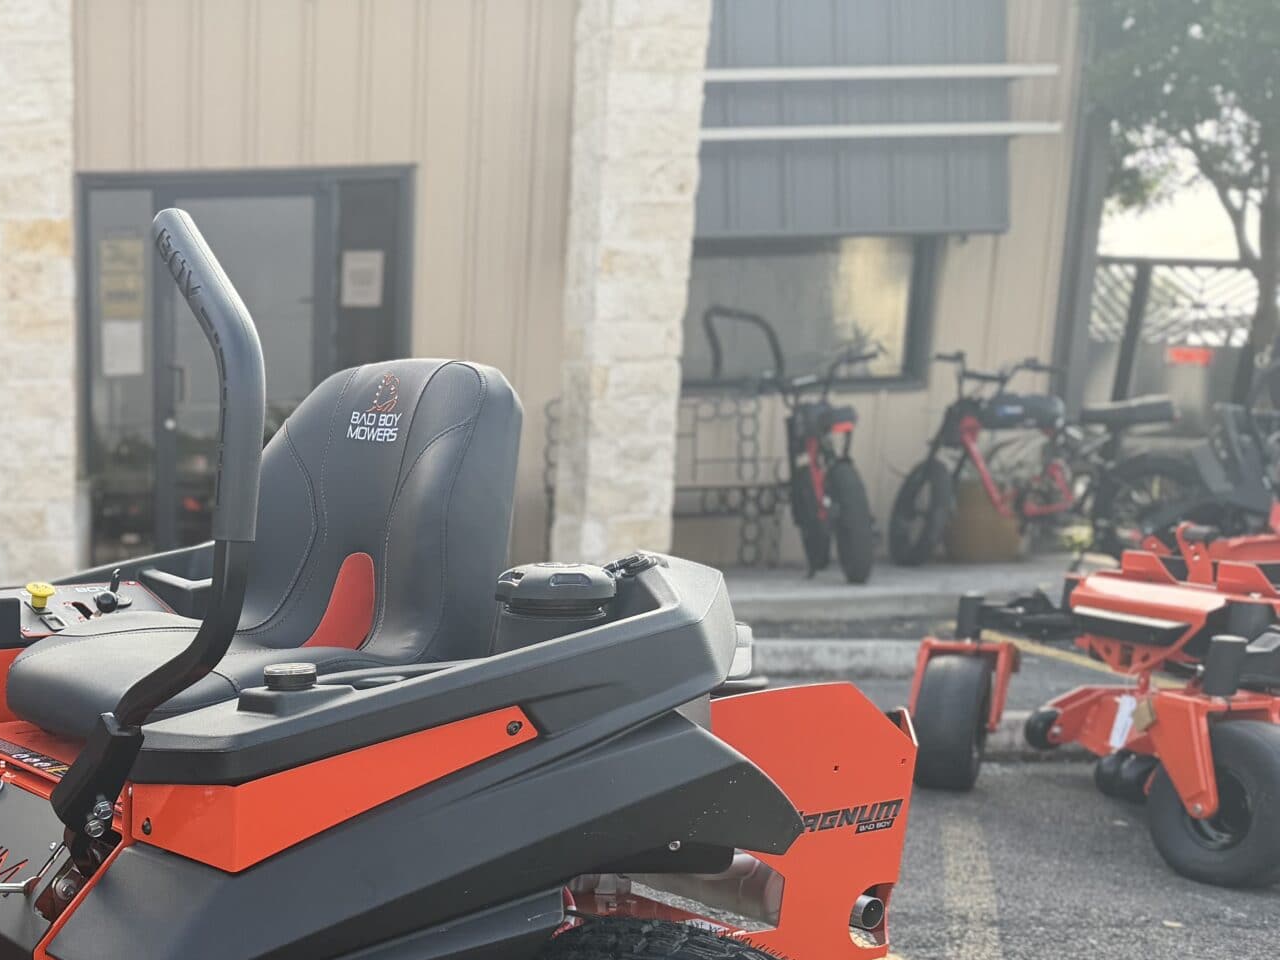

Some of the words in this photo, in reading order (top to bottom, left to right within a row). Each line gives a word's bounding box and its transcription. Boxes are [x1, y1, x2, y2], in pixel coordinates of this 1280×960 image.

[350, 411, 376, 426] BAD
[378, 412, 402, 427] BOY
[346, 424, 399, 442] MOWERS
[799, 799, 904, 833] AGNUM
[859, 823, 875, 832] BAD
[876, 820, 892, 829] BOY
